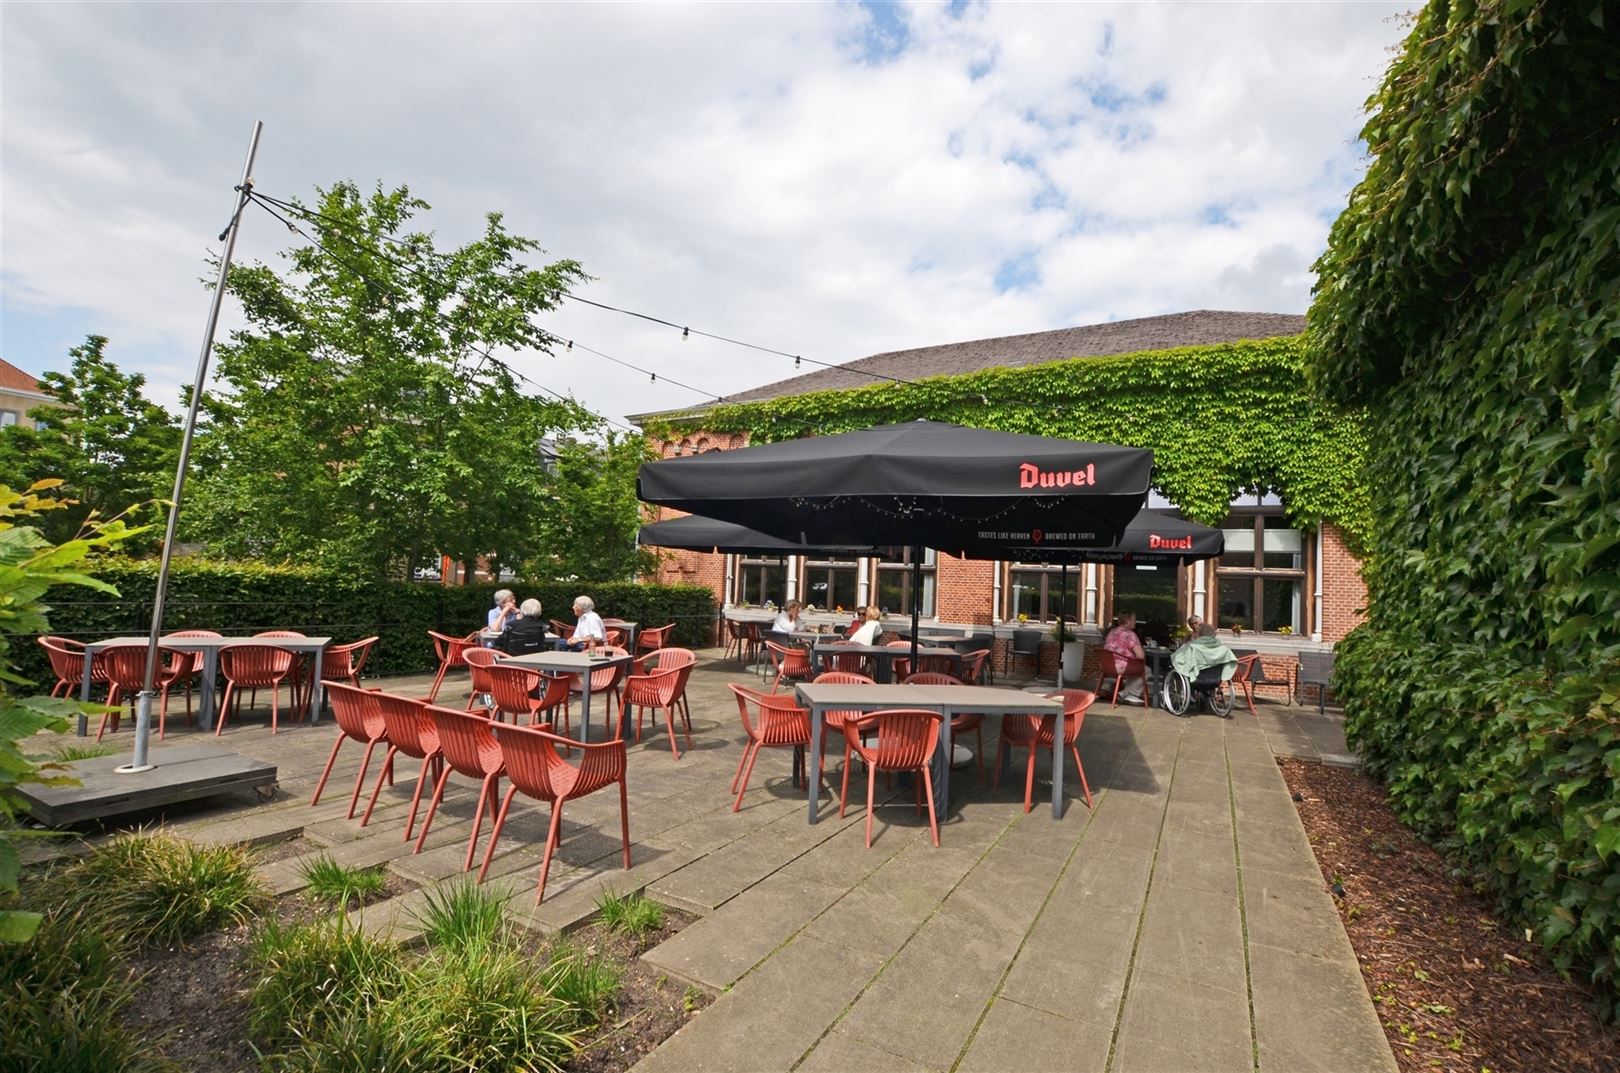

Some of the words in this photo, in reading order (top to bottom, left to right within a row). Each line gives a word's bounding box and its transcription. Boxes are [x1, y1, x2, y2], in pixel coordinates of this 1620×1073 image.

[1019, 463, 1096, 489] Duvel
[978, 531, 997, 540] TASTES
[998, 532, 1009, 540] LIKE
[1010, 532, 1031, 540] HEAVEN
[1045, 532, 1068, 541] BREWED
[1068, 533, 1077, 541] ON
[1078, 532, 1096, 541] EARTH
[1149, 534, 1192, 549] Duvel
